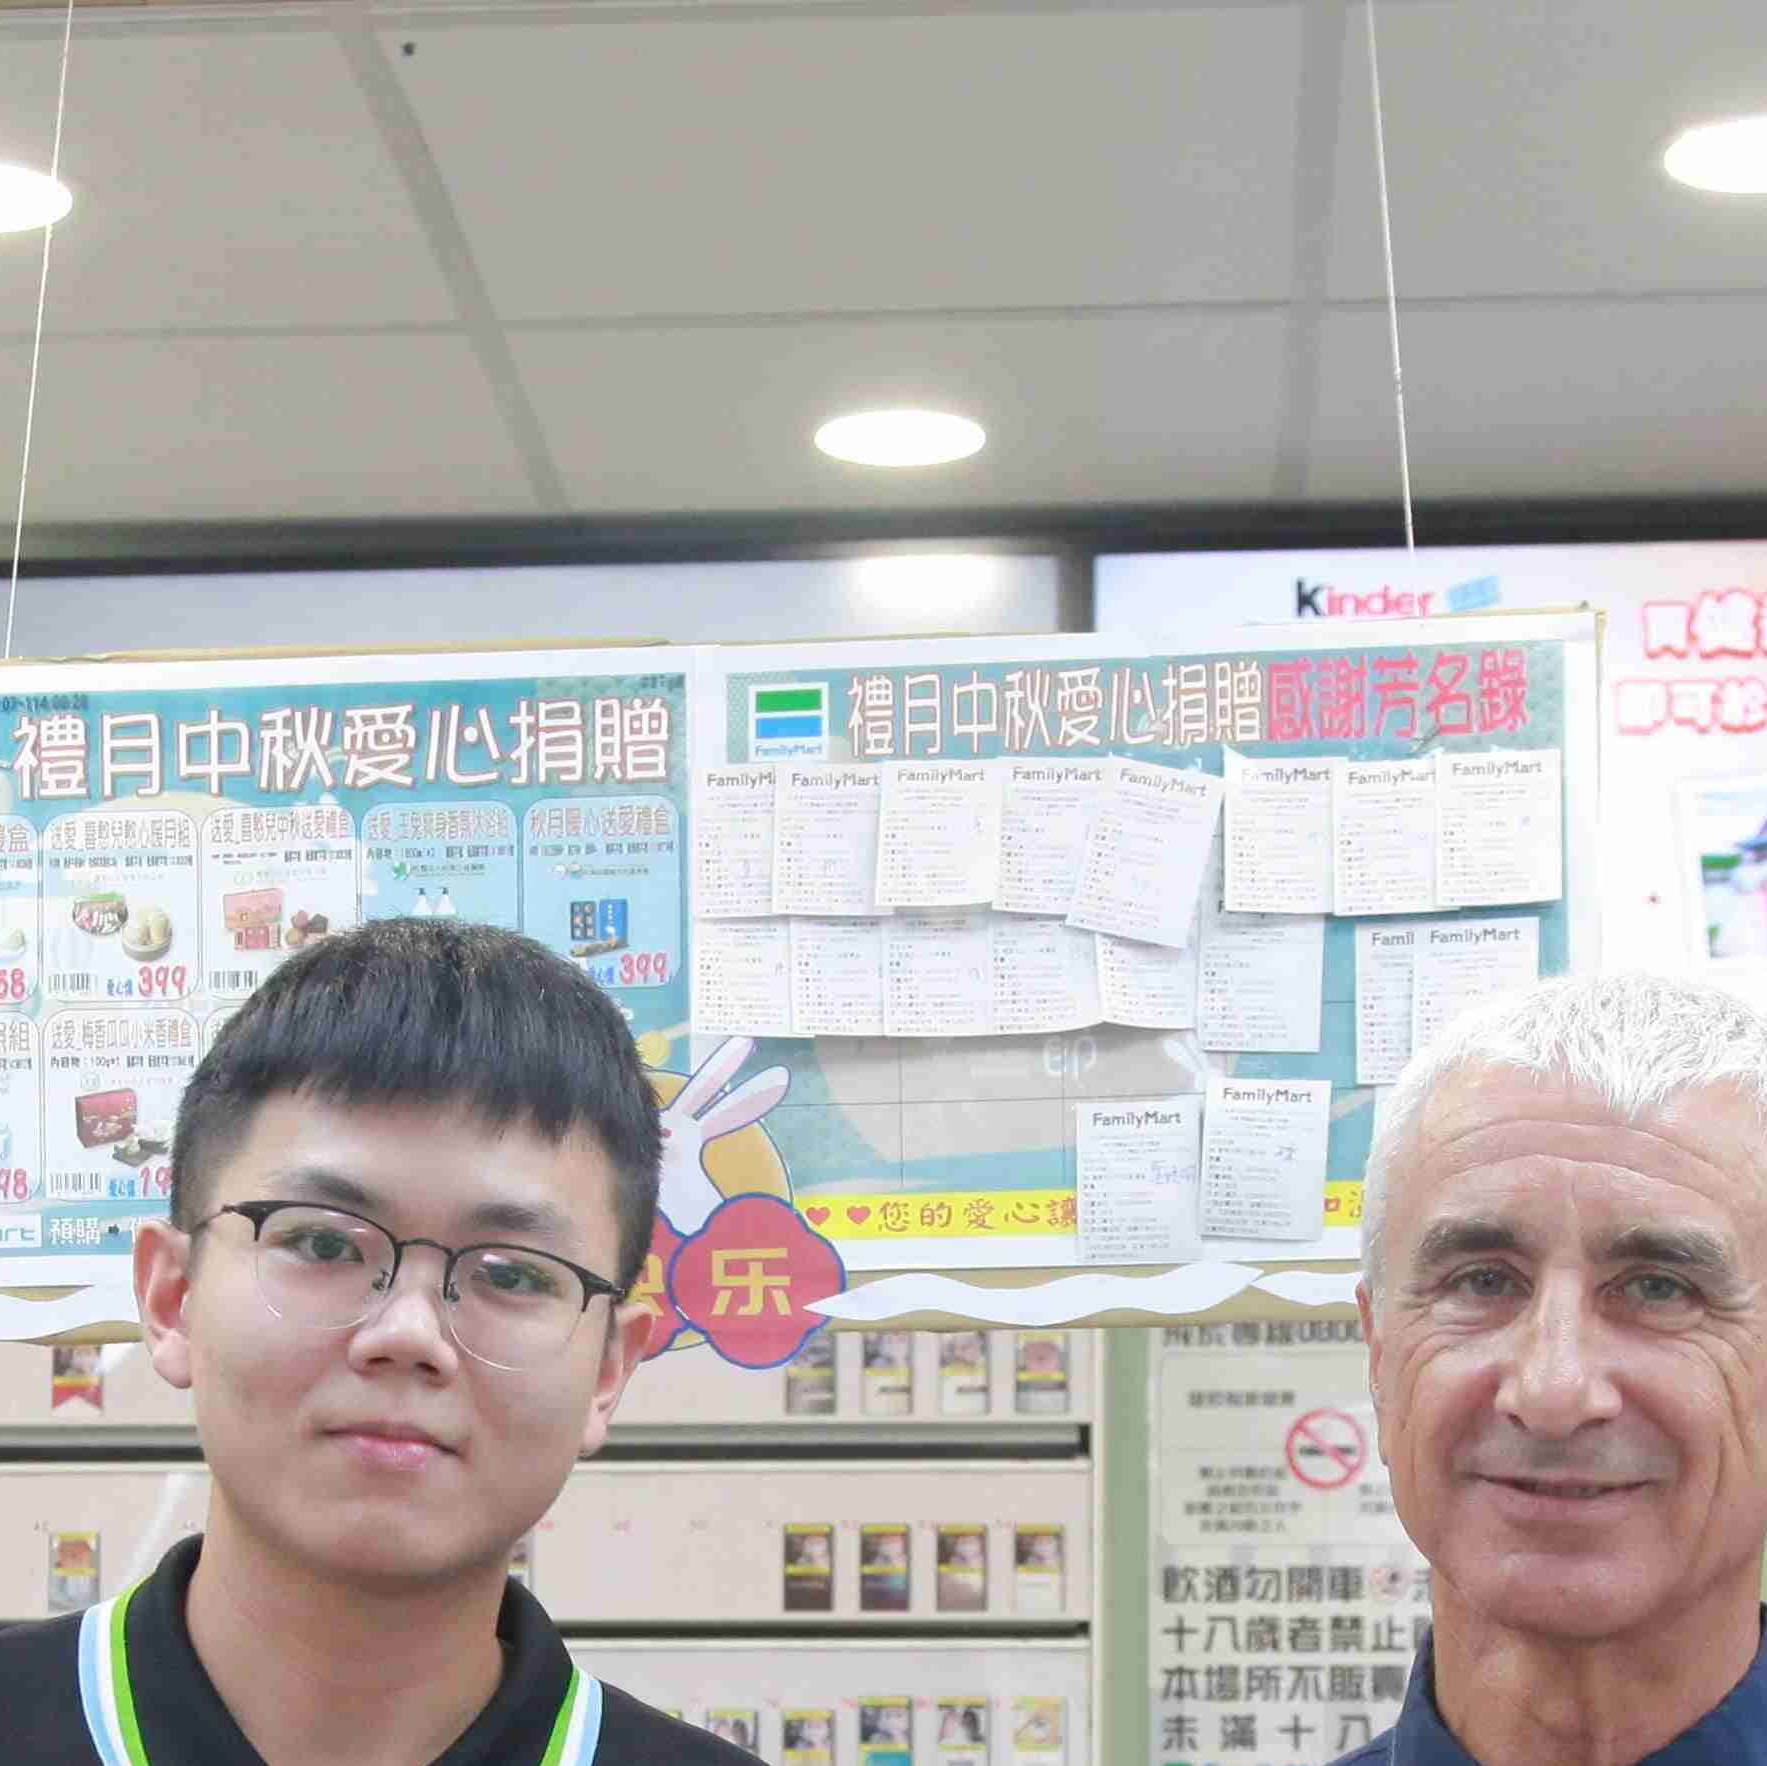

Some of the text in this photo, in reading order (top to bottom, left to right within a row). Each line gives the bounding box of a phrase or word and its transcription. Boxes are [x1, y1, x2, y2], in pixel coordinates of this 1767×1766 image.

[1295, 579, 1436, 618] Kinder
[10, 696, 672, 802] 禮月中秋愛心捐贈
[754, 743, 823, 758] FamilyMart
[896, 767, 986, 785] FamilyMart
[1012, 766, 1102, 784] FamilyMart
[1452, 760, 1542, 777] FamilyMart
[706, 773, 777, 789] FamilyM
[791, 771, 880, 788] FamilyMart
[1119, 768, 1207, 798] FamilyMart
[1371, 931, 1415, 947] Famil
[1430, 927, 1521, 945] FamilyMart
[619, 952, 668, 985] 399
[138, 963, 187, 998] 399
[1222, 1087, 1313, 1105] FamilyMart
[1092, 1110, 1182, 1128] FamilyMart
[139, 1166, 173, 1198] 19
[50, 1218, 100, 1246] 預購
[1162, 1565, 1364, 1603] 飲酒勿開車
[1162, 1665, 1407, 1702] 本場所不販賣
